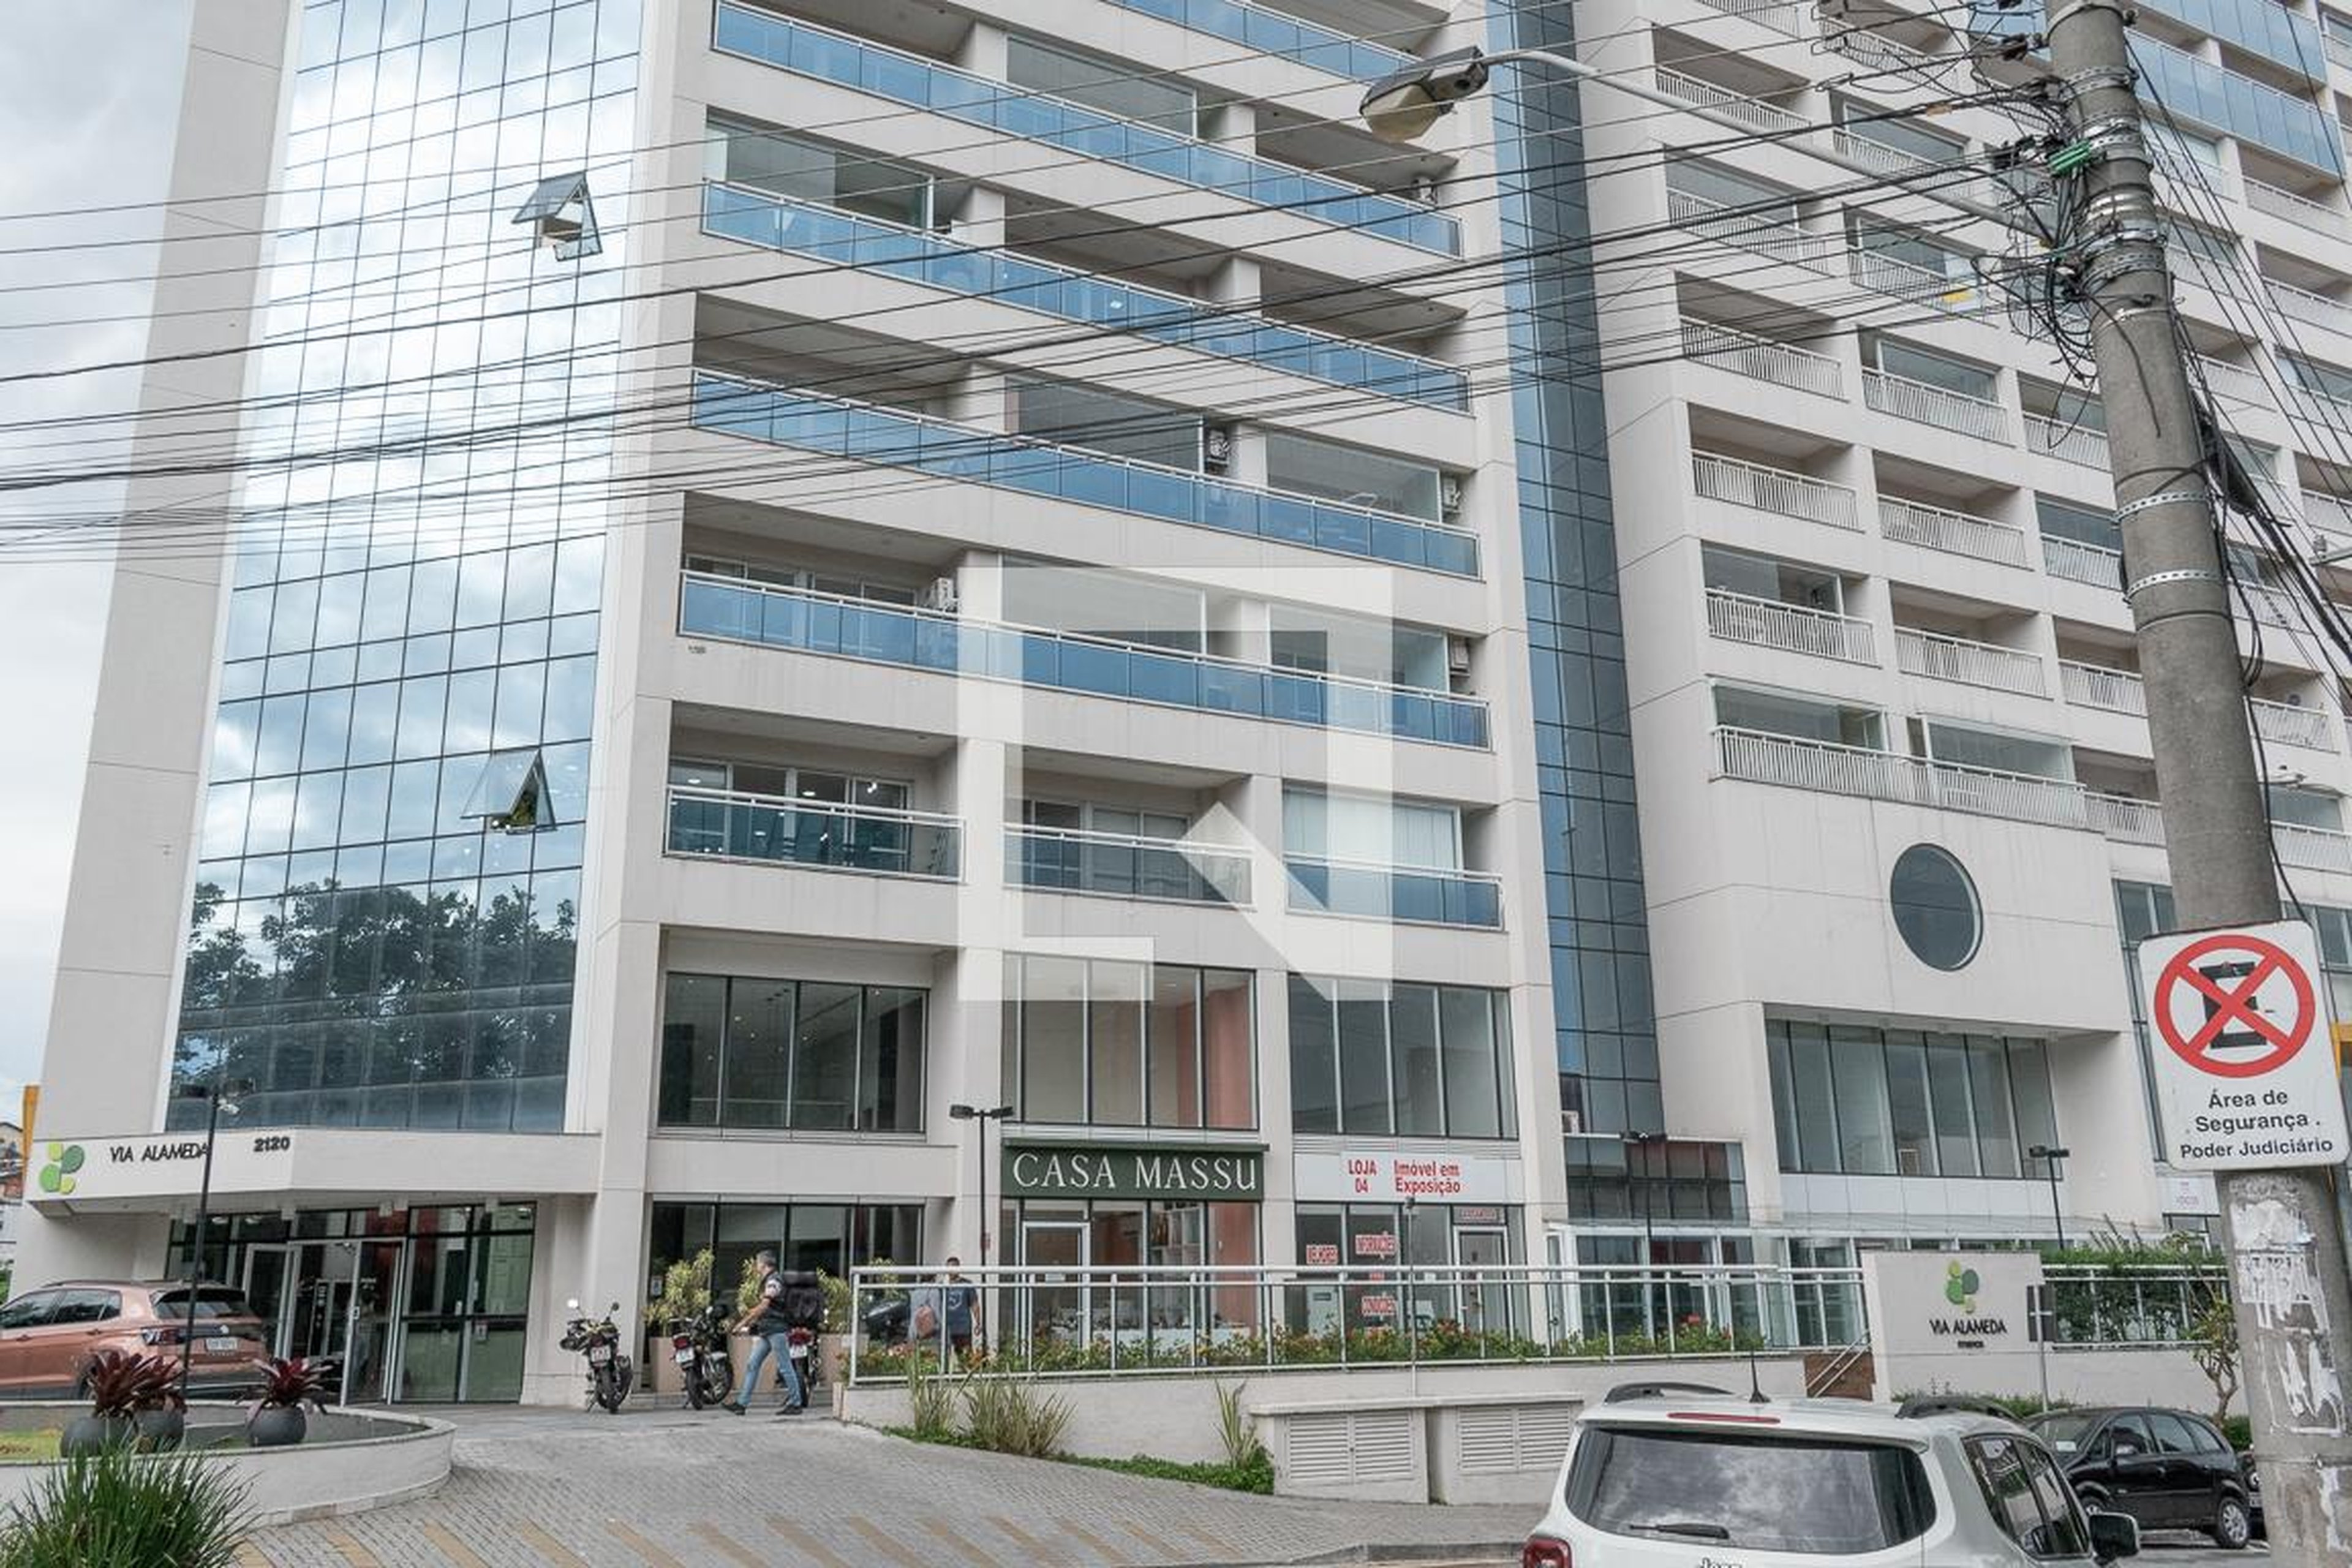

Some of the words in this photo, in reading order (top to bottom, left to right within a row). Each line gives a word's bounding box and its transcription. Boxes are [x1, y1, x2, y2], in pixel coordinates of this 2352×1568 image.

[2208, 1088, 2256, 1109] Área
[2263, 1089, 2288, 1106] de
[2195, 1113, 2309, 1135] Segurança
[254, 1136, 292, 1153] 2120
[2180, 1142, 2233, 1158] Poder
[2239, 1137, 2333, 1156] Judiciário
[109, 1145, 134, 1163] VIA
[1012, 1152, 1116, 1188] CASA
[1135, 1156, 1256, 1191] MASSU
[1348, 1159, 1378, 1175] LOJA
[1394, 1159, 1437, 1176] Imóvel
[1441, 1164, 1460, 1176] em
[1355, 1178, 1369, 1193] 04
[1395, 1177, 1461, 1197] Exposição
[1929, 1319, 1951, 1334] VIA
[1953, 1319, 2008, 1335] ALAMEDA
